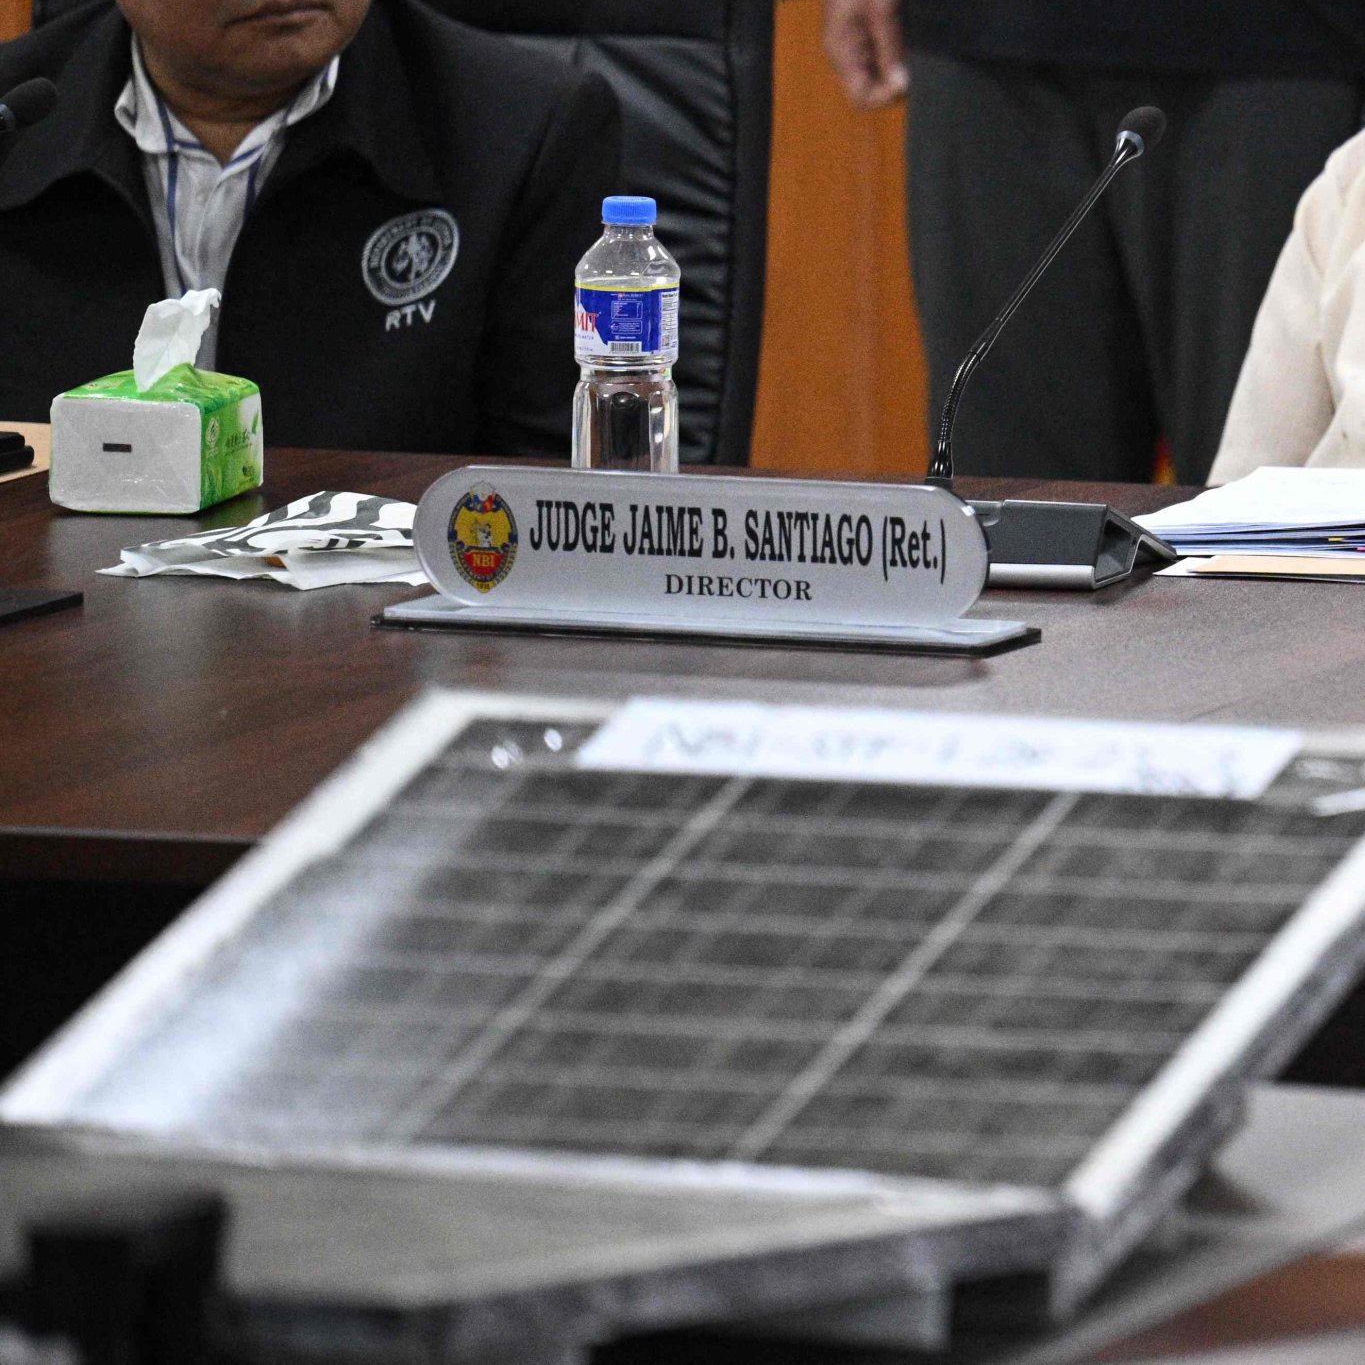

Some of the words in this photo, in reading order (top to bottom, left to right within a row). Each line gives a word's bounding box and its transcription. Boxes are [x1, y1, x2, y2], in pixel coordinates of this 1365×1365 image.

[385, 299, 437, 332] RTV
[530, 500, 615, 554] JUDGE
[623, 504, 703, 558] JAIME
[712, 508, 735, 560] B.
[744, 509, 874, 567] SANTIAGO
[882, 516, 947, 584] (Ret.)
[472, 553, 496, 568] NBI
[665, 573, 813, 601] DIRECTOR
